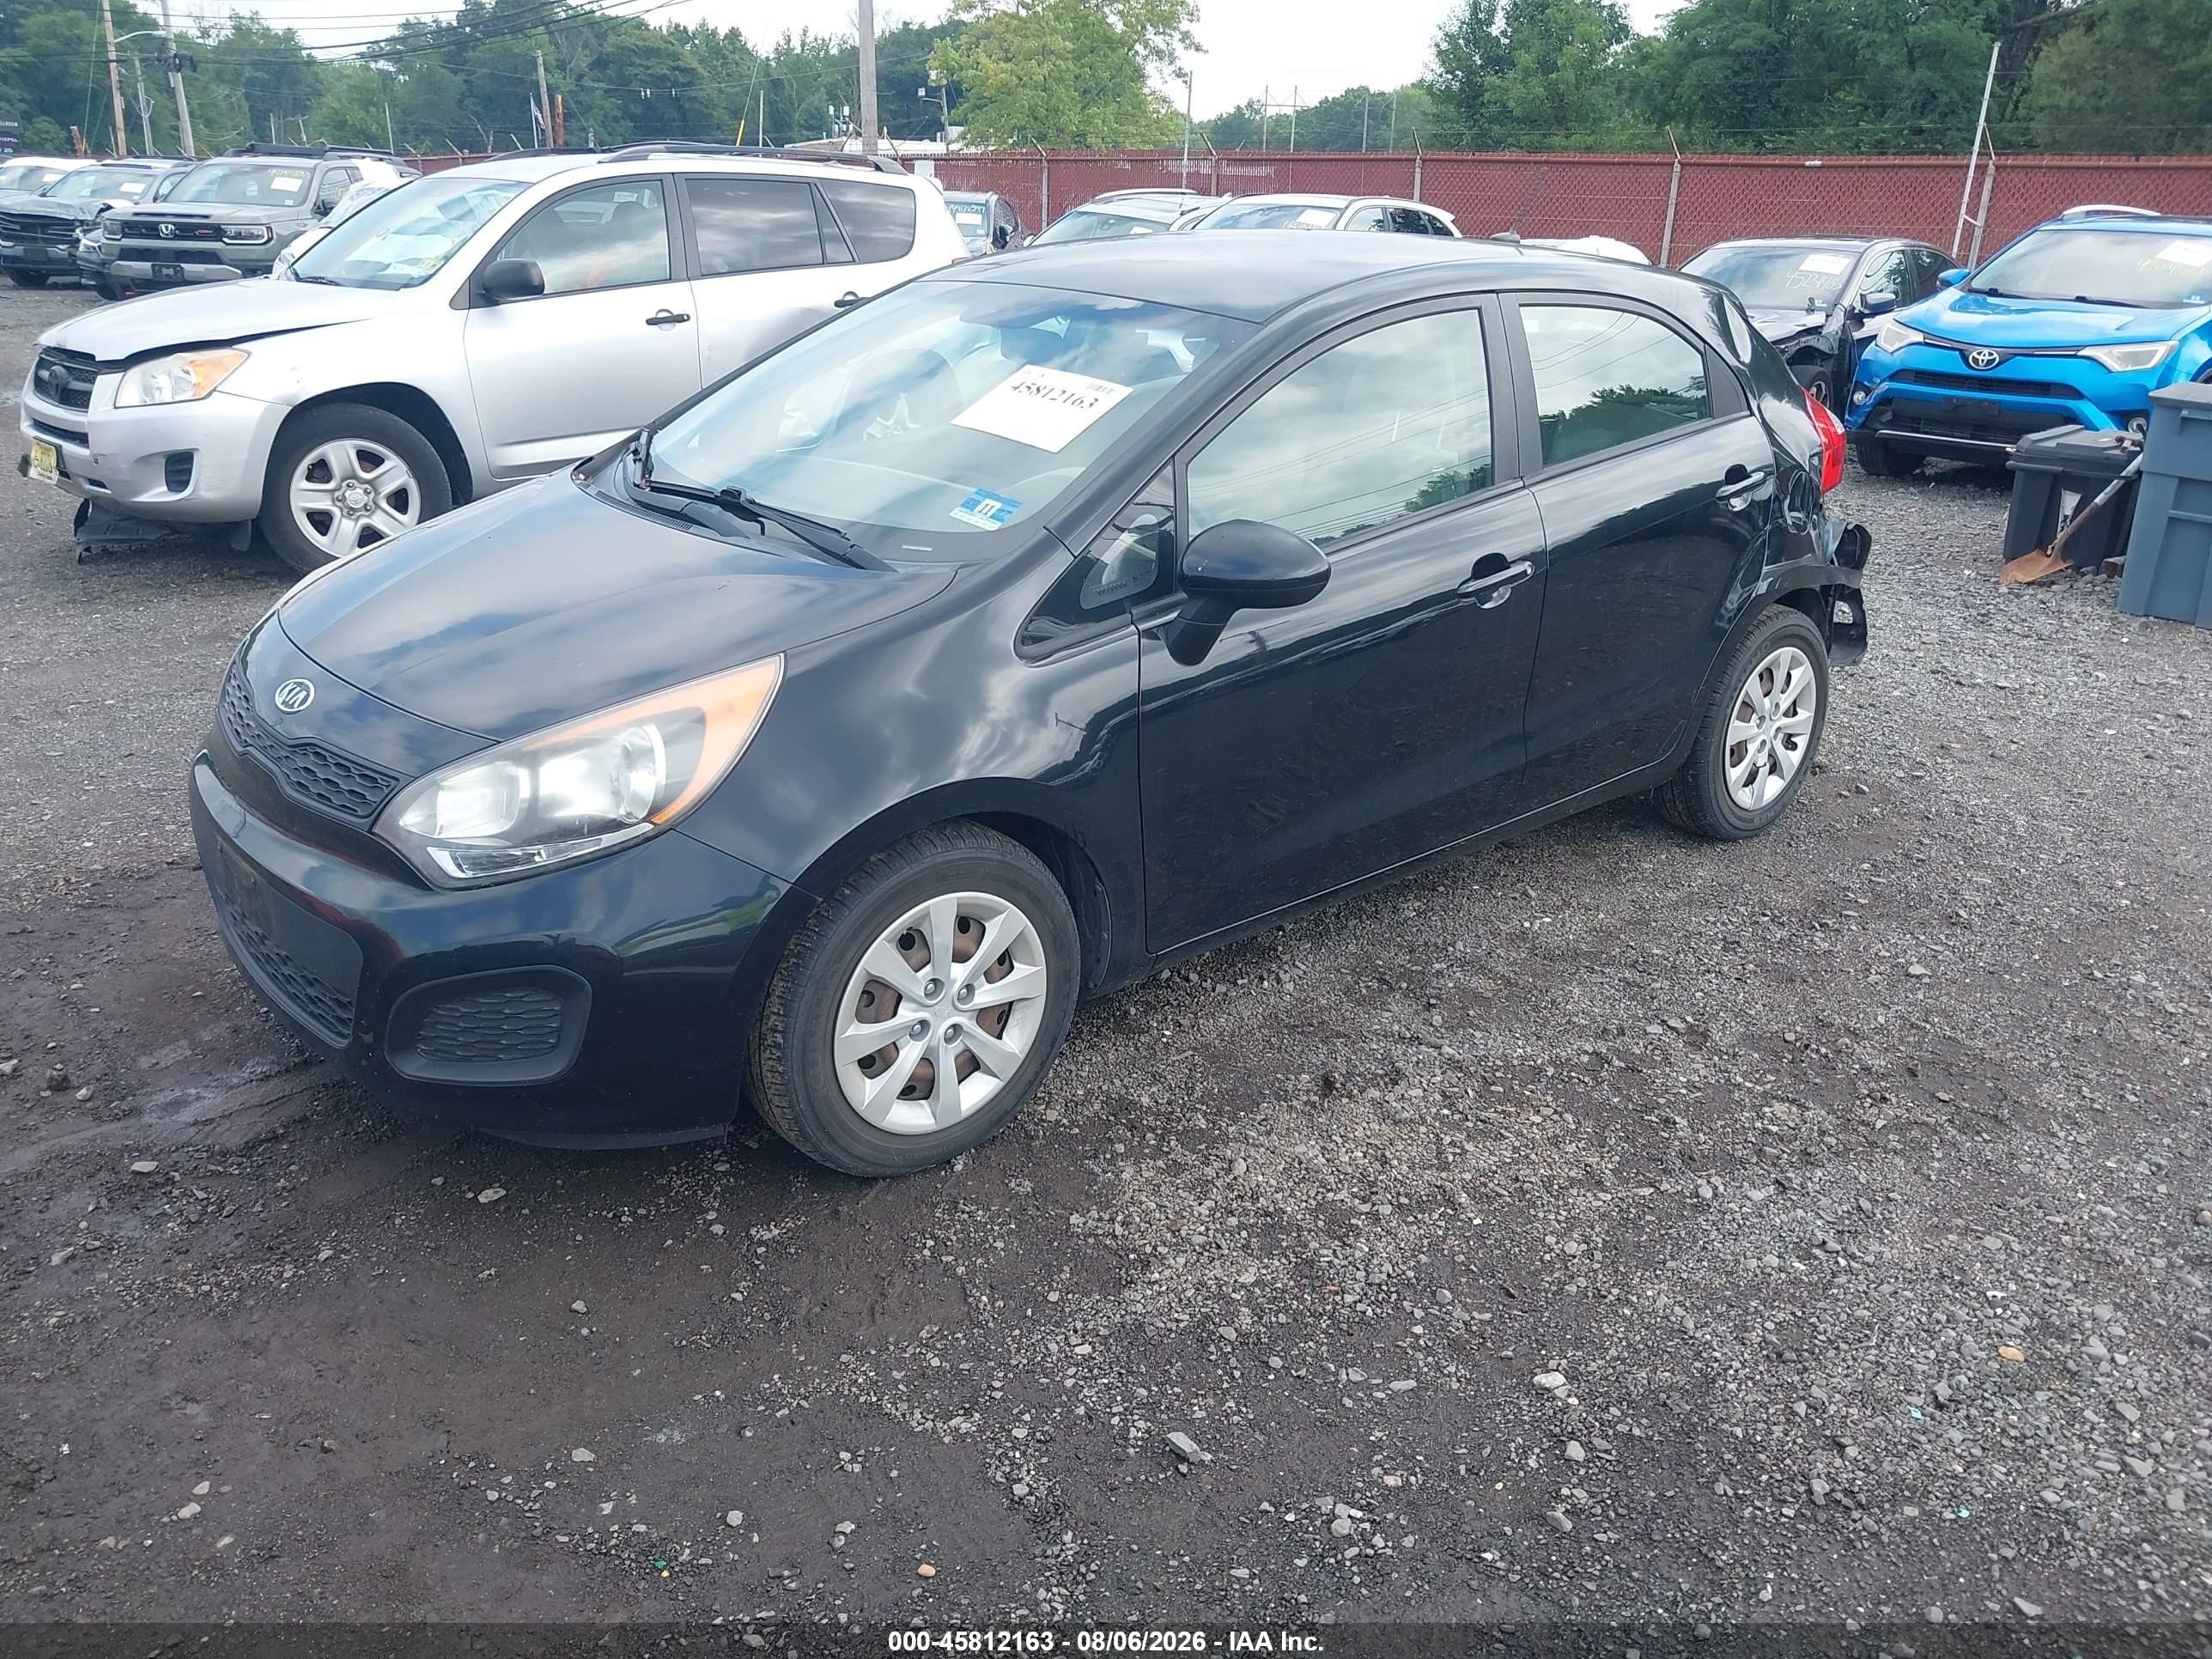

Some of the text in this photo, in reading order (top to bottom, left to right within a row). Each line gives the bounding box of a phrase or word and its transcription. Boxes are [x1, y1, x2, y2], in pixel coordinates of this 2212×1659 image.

[1011, 381, 1099, 409] 45812163
[976, 503, 996, 516] 11
[276, 681, 311, 710] KIA
